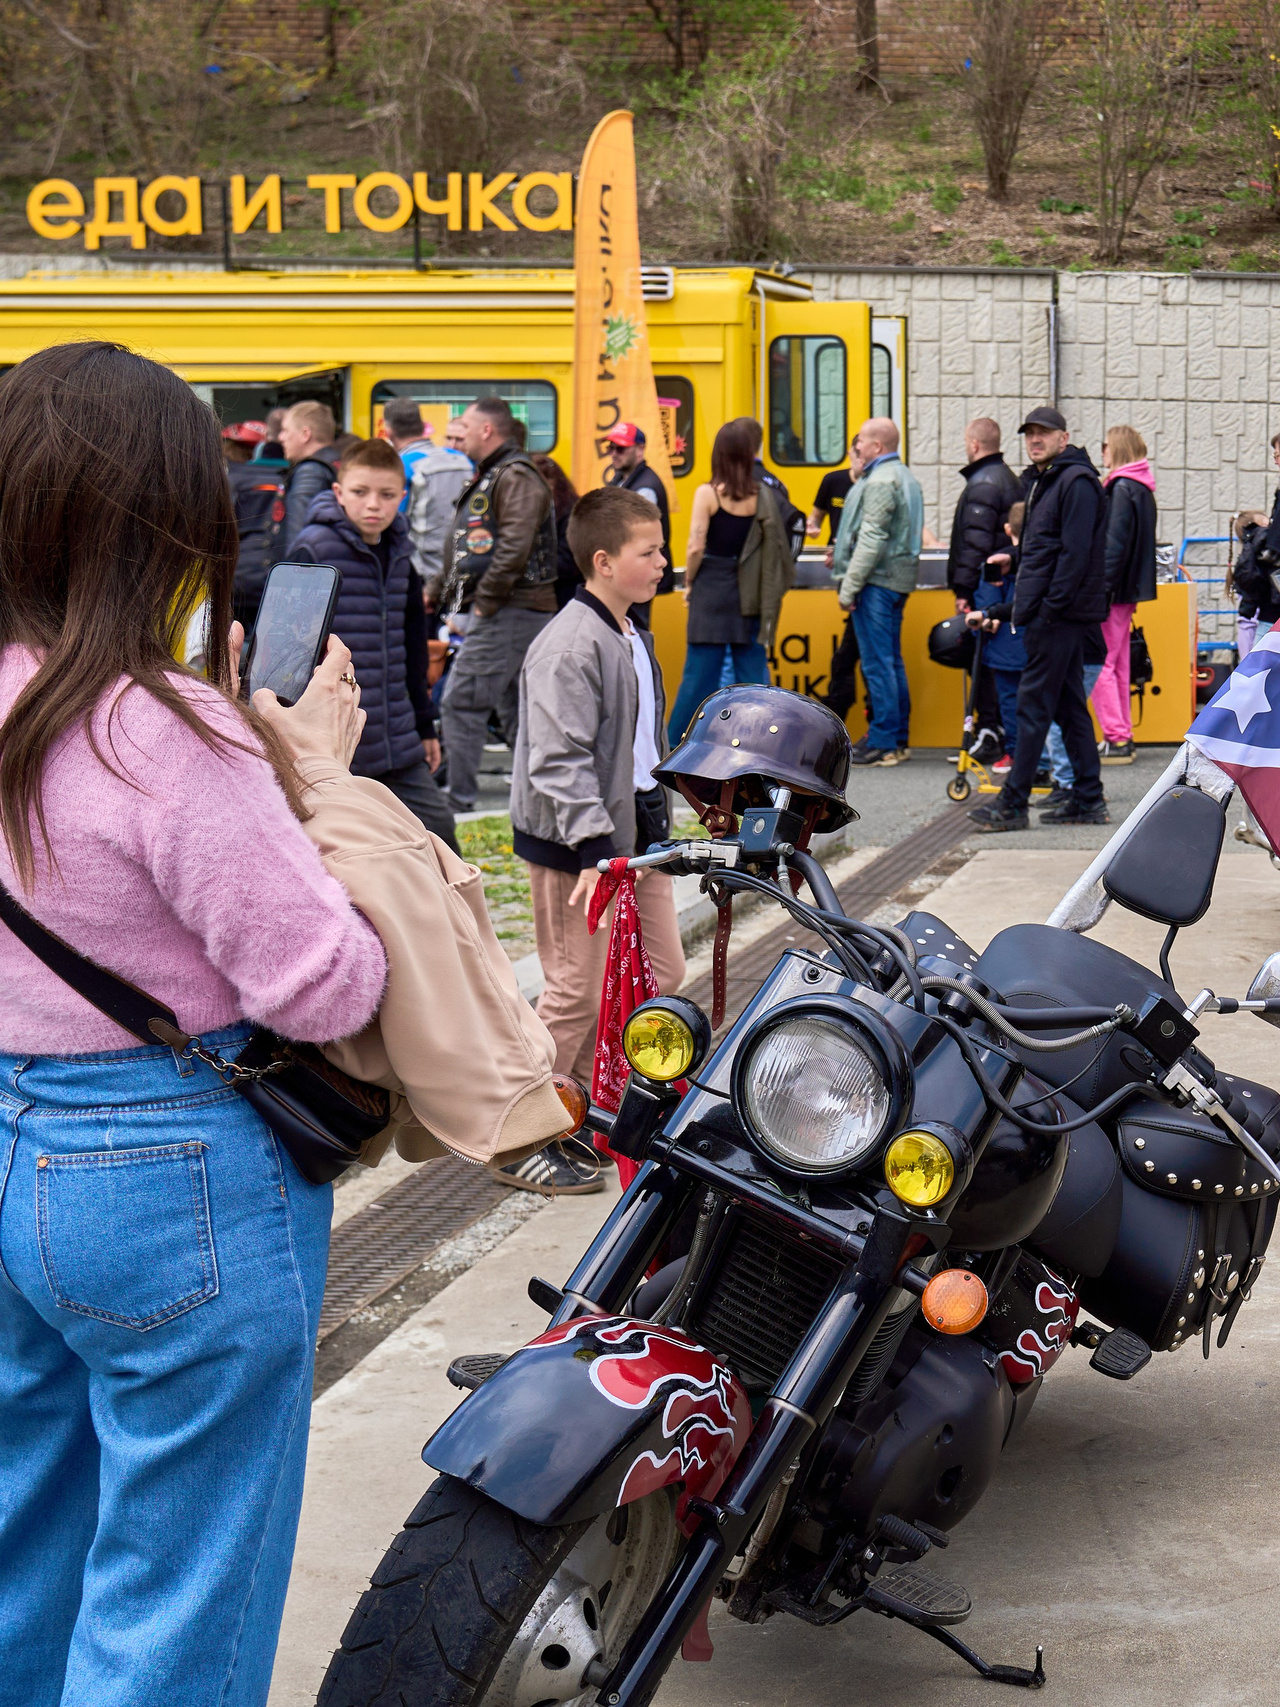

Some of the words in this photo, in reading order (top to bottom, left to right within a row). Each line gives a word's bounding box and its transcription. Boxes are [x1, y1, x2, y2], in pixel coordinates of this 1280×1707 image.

[26, 176, 202, 249] еда
[231, 174, 282, 233] и
[307, 171, 573, 233] точка
